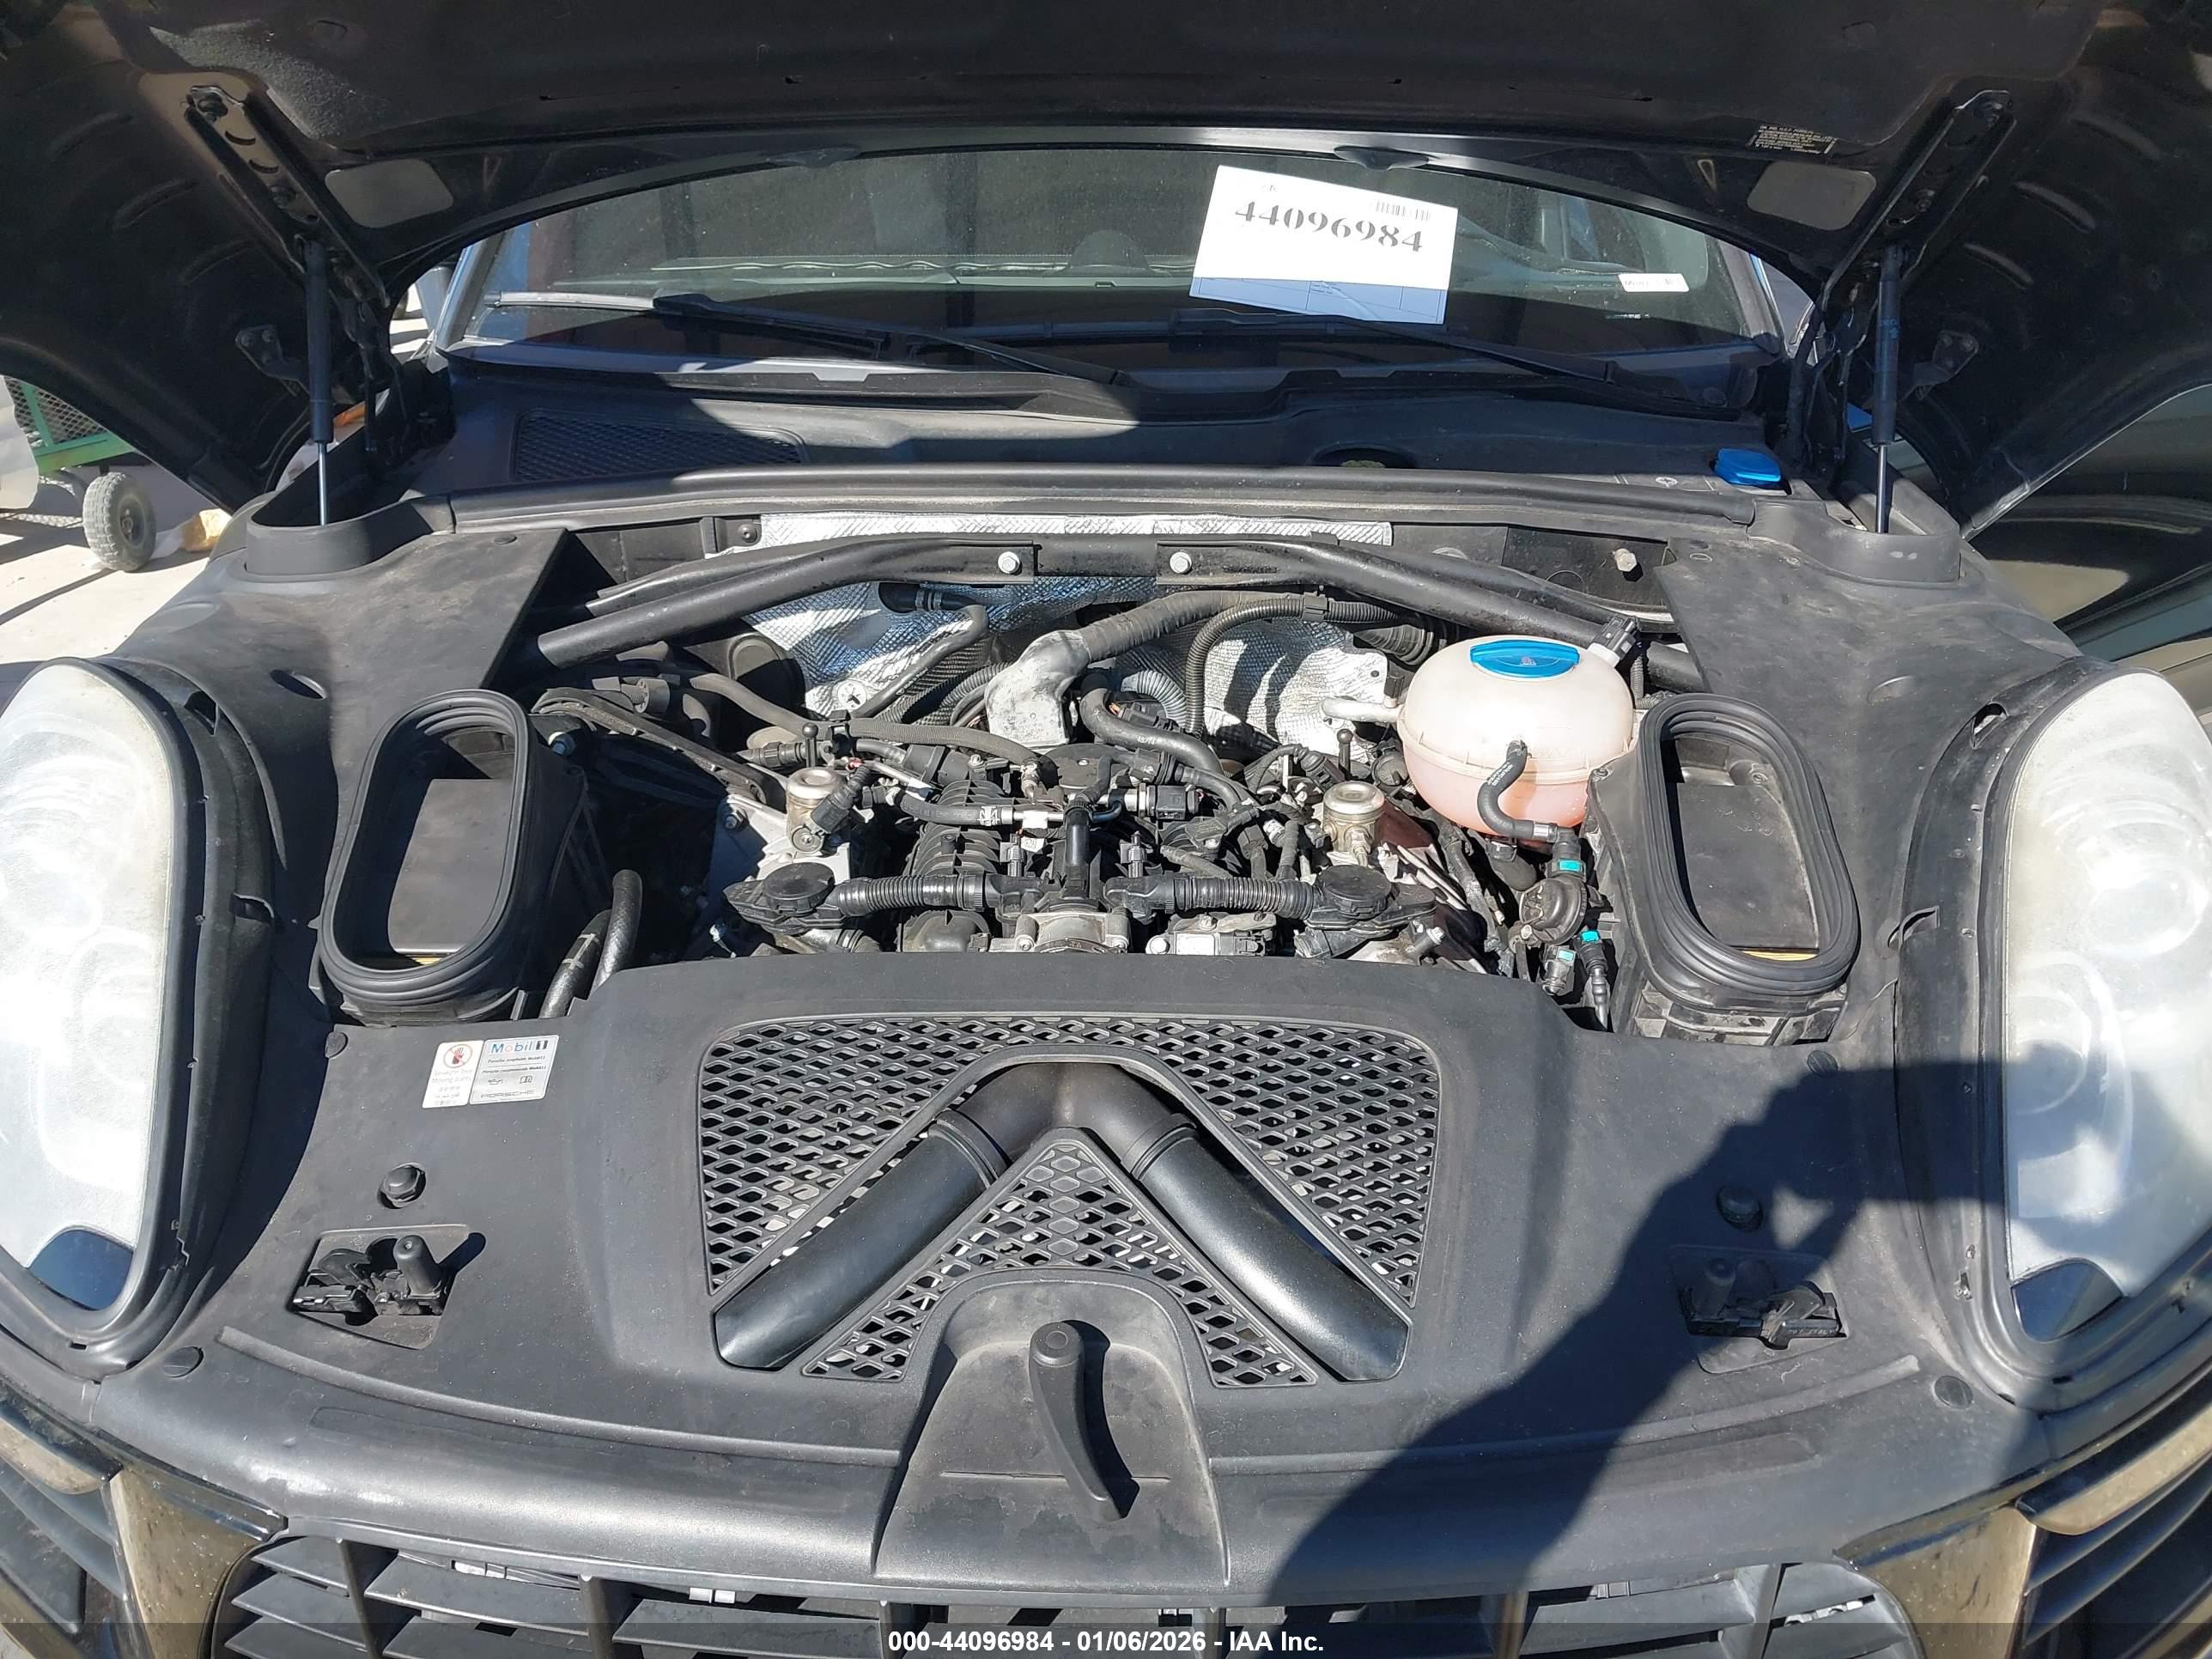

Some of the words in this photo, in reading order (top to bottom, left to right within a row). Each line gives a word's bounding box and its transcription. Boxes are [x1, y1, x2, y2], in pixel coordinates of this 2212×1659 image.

[1235, 201, 1423, 252] 44096984
[490, 1042, 532, 1054] Mobil
[480, 1090, 535, 1098] PORSCHE
